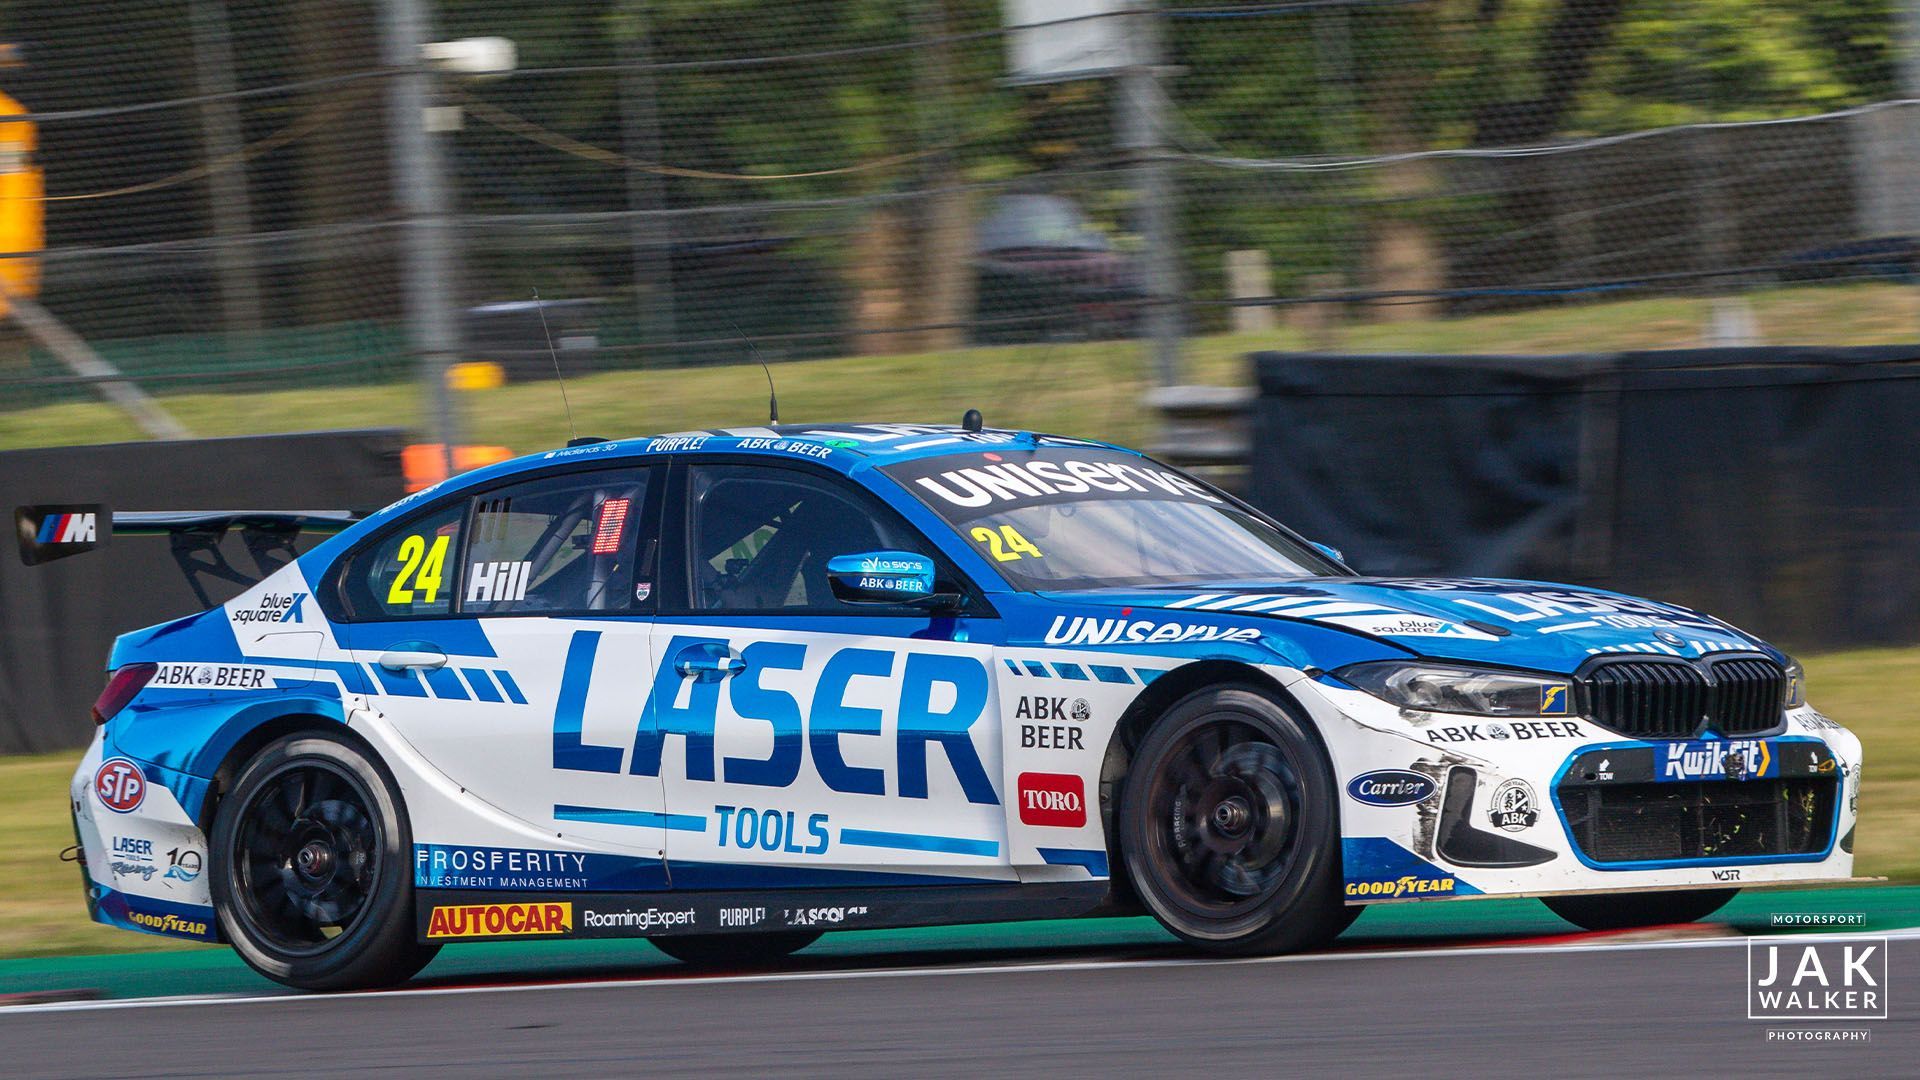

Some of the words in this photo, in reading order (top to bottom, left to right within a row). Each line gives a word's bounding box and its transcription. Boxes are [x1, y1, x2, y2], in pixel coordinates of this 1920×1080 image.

[646, 437, 709, 453] PURPLE!
[736, 438, 776, 450] ABK
[786, 441, 833, 459] BEER
[970, 525, 1043, 562] 24
[387, 535, 450, 604] 24
[467, 561, 532, 602] Hill
[859, 577, 885, 588] ABK
[895, 580, 923, 591] BEER
[260, 593, 292, 609] blue
[232, 609, 282, 625] square
[1399, 620, 1440, 628] blue
[1372, 625, 1435, 634] square
[154, 665, 198, 685] ABK
[214, 667, 265, 688] BEER
[553, 630, 1000, 805] LASER
[1015, 696, 1068, 720] ABK
[1021, 724, 1084, 750] BEER
[1426, 725, 1488, 743] ABK
[1509, 721, 1587, 740] BEER
[100, 766, 140, 804] STP
[1599, 772, 1614, 781] TOW
[1358, 779, 1425, 797] Carrier
[1023, 790, 1082, 811] TORO
[1501, 812, 1530, 825] ABK
[715, 805, 830, 855] TOOLS
[113, 836, 153, 855] LASER
[500, 877, 588, 888] MANAGEMENT
[1712, 869, 1741, 881] WSR
[429, 904, 564, 935] AUTOCAR
[584, 907, 696, 930] RoamingExpert
